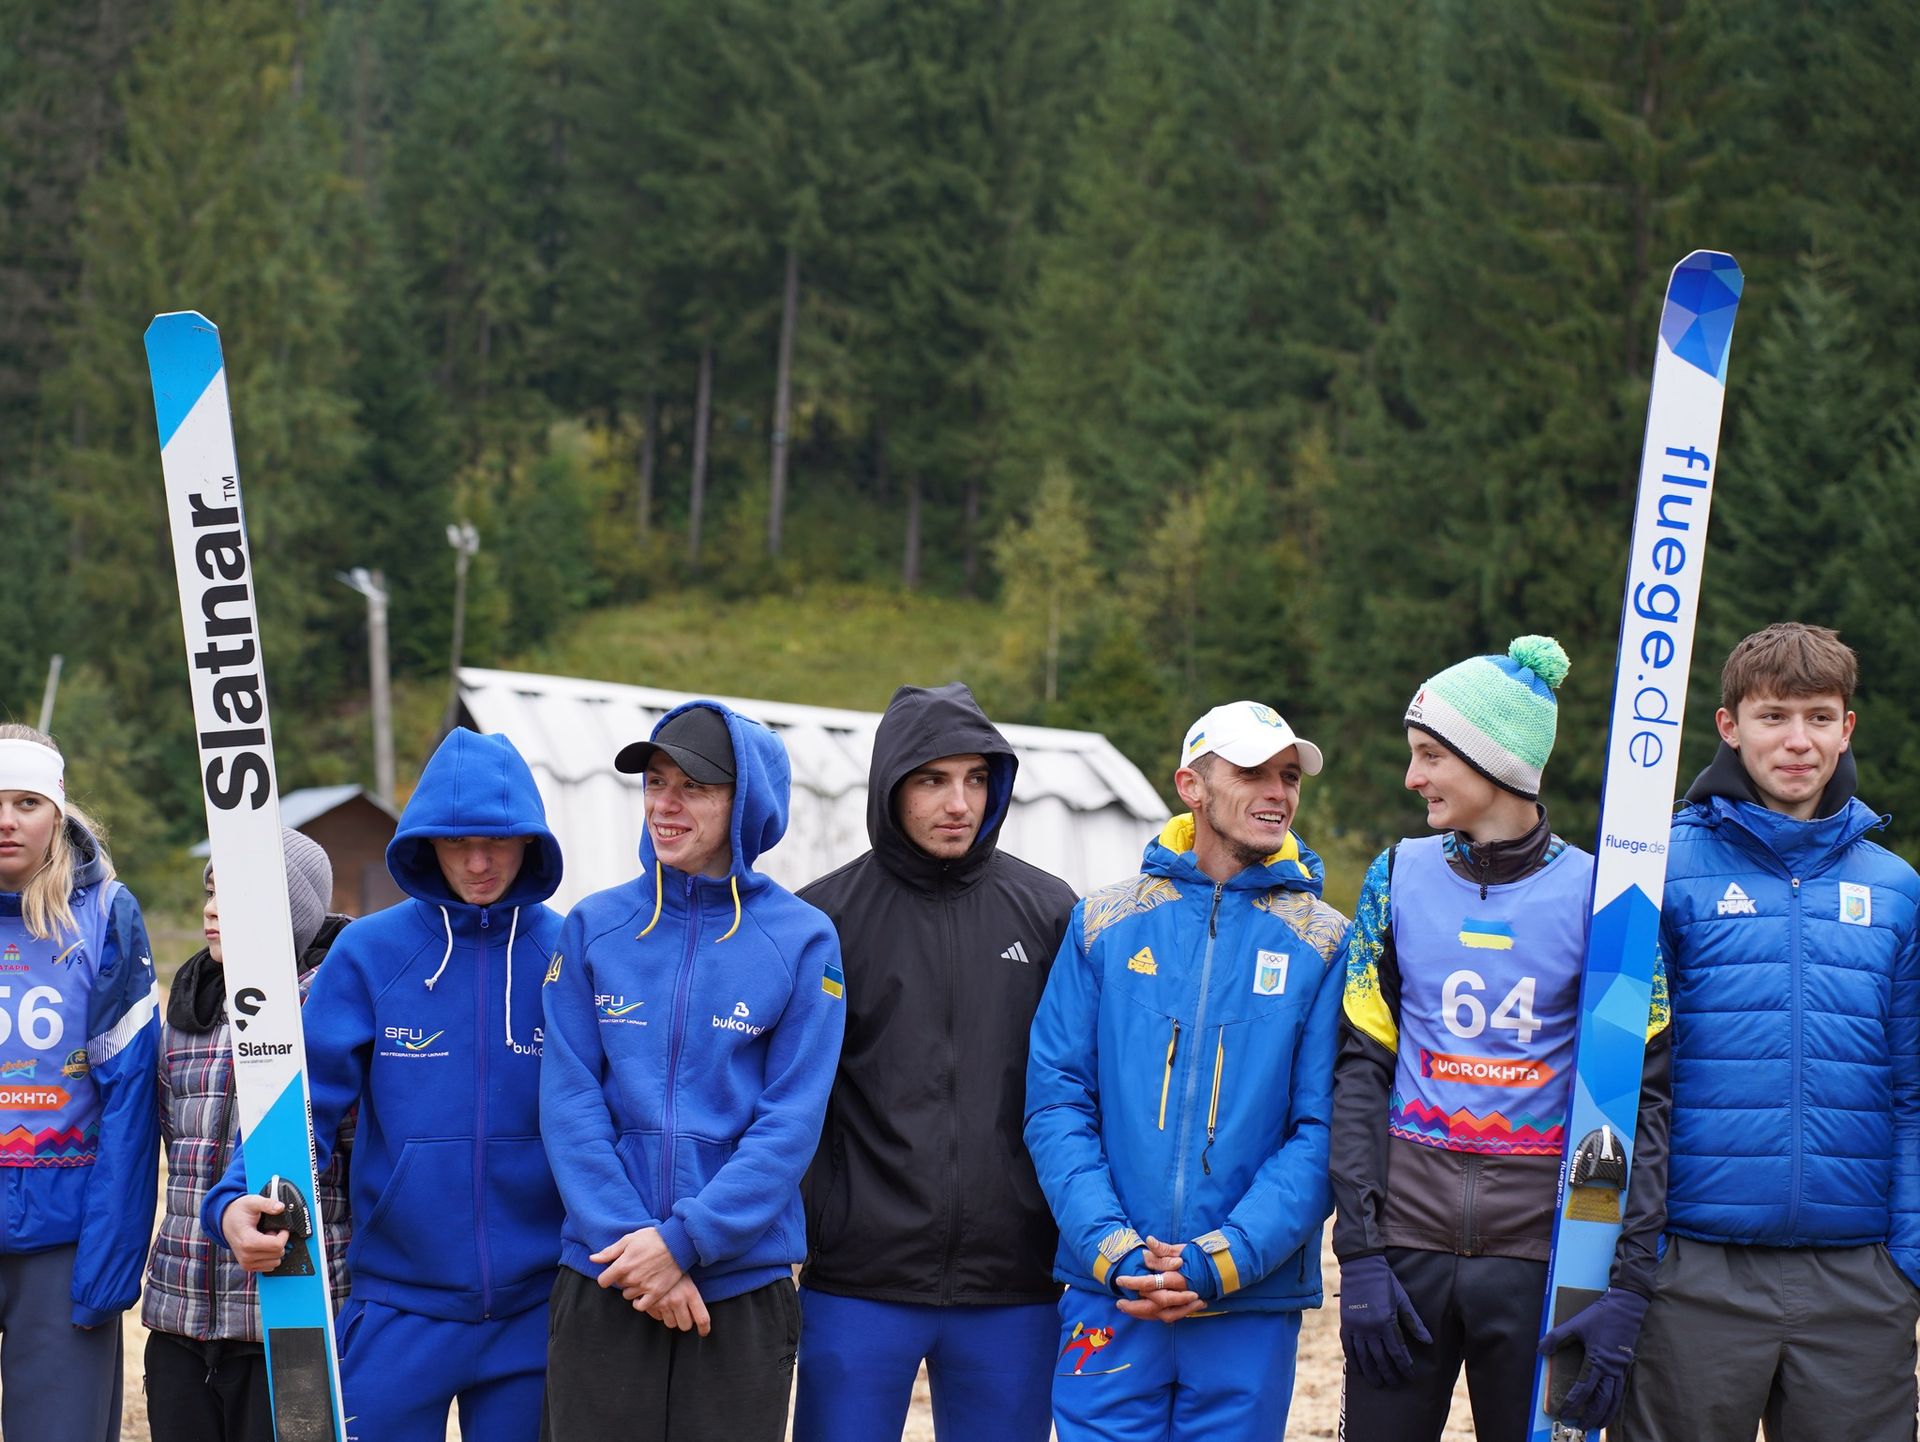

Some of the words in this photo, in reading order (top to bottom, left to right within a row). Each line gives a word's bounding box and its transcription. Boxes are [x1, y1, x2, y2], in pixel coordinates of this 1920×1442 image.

[221, 475, 237, 502] TM
[1628, 446, 1711, 768] fluege.de
[188, 493, 271, 811] Slatnar
[1605, 834, 1666, 855] fluege.de
[1716, 899, 1758, 916] PEAK
[1441, 969, 1543, 1044] 64
[384, 1026, 423, 1040] SFU
[238, 1042, 293, 1057] Slatnar
[1437, 1059, 1540, 1081] VOROKHTA
[1569, 1149, 1583, 1184] Slatnar
[1555, 1160, 1567, 1209] fluege.de
[302, 1205, 312, 1235] Slatnar
